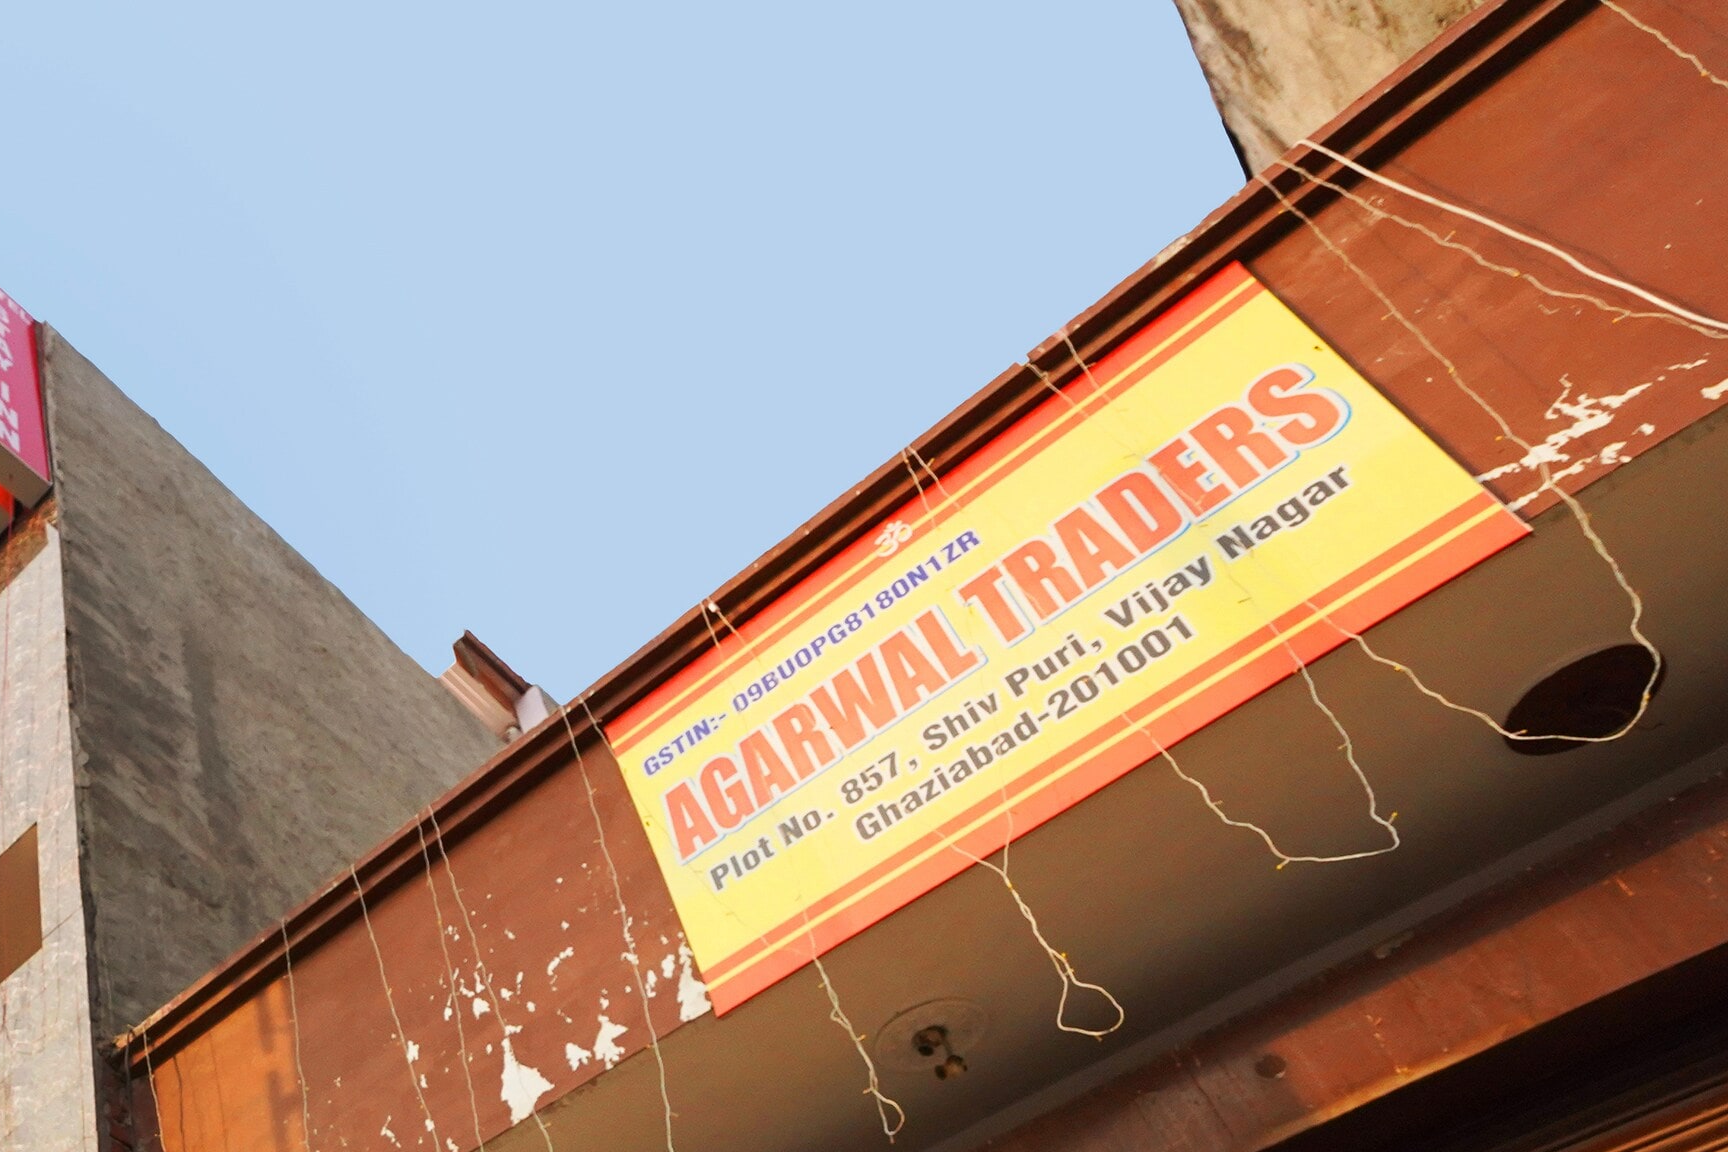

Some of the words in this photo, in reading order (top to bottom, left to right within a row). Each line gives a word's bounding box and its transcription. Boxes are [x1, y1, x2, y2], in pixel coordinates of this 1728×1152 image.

[644, 712, 726, 777] GSTIN:-
[662, 607, 985, 864] AGARWAL
[958, 364, 1348, 646] TRADERS
[710, 837, 774, 890] Plot
[777, 807, 835, 846] No.
[840, 751, 918, 805] 857,
[922, 692, 999, 751] Shiv
[1005, 634, 1102, 698] Puri,
[1104, 556, 1212, 629] Vijay
[1216, 466, 1351, 560] Nagar
[855, 615, 1195, 841] Ghaziabad-201001
